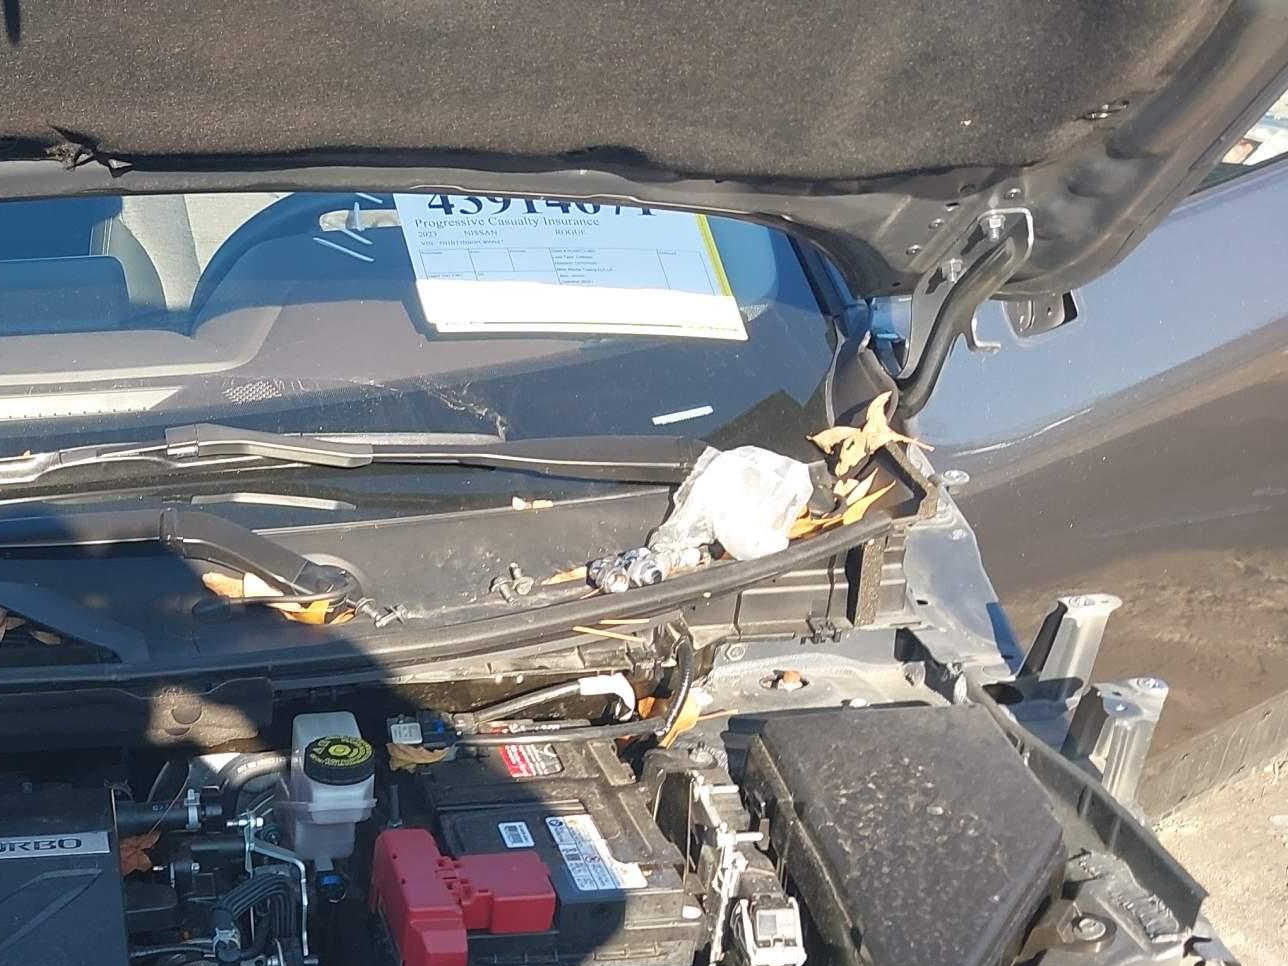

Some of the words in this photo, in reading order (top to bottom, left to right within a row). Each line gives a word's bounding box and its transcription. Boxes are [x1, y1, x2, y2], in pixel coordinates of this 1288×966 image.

[414, 217, 485, 229] Progressive
[488, 216, 539, 228] Casualty
[543, 217, 600, 227] Insurance
